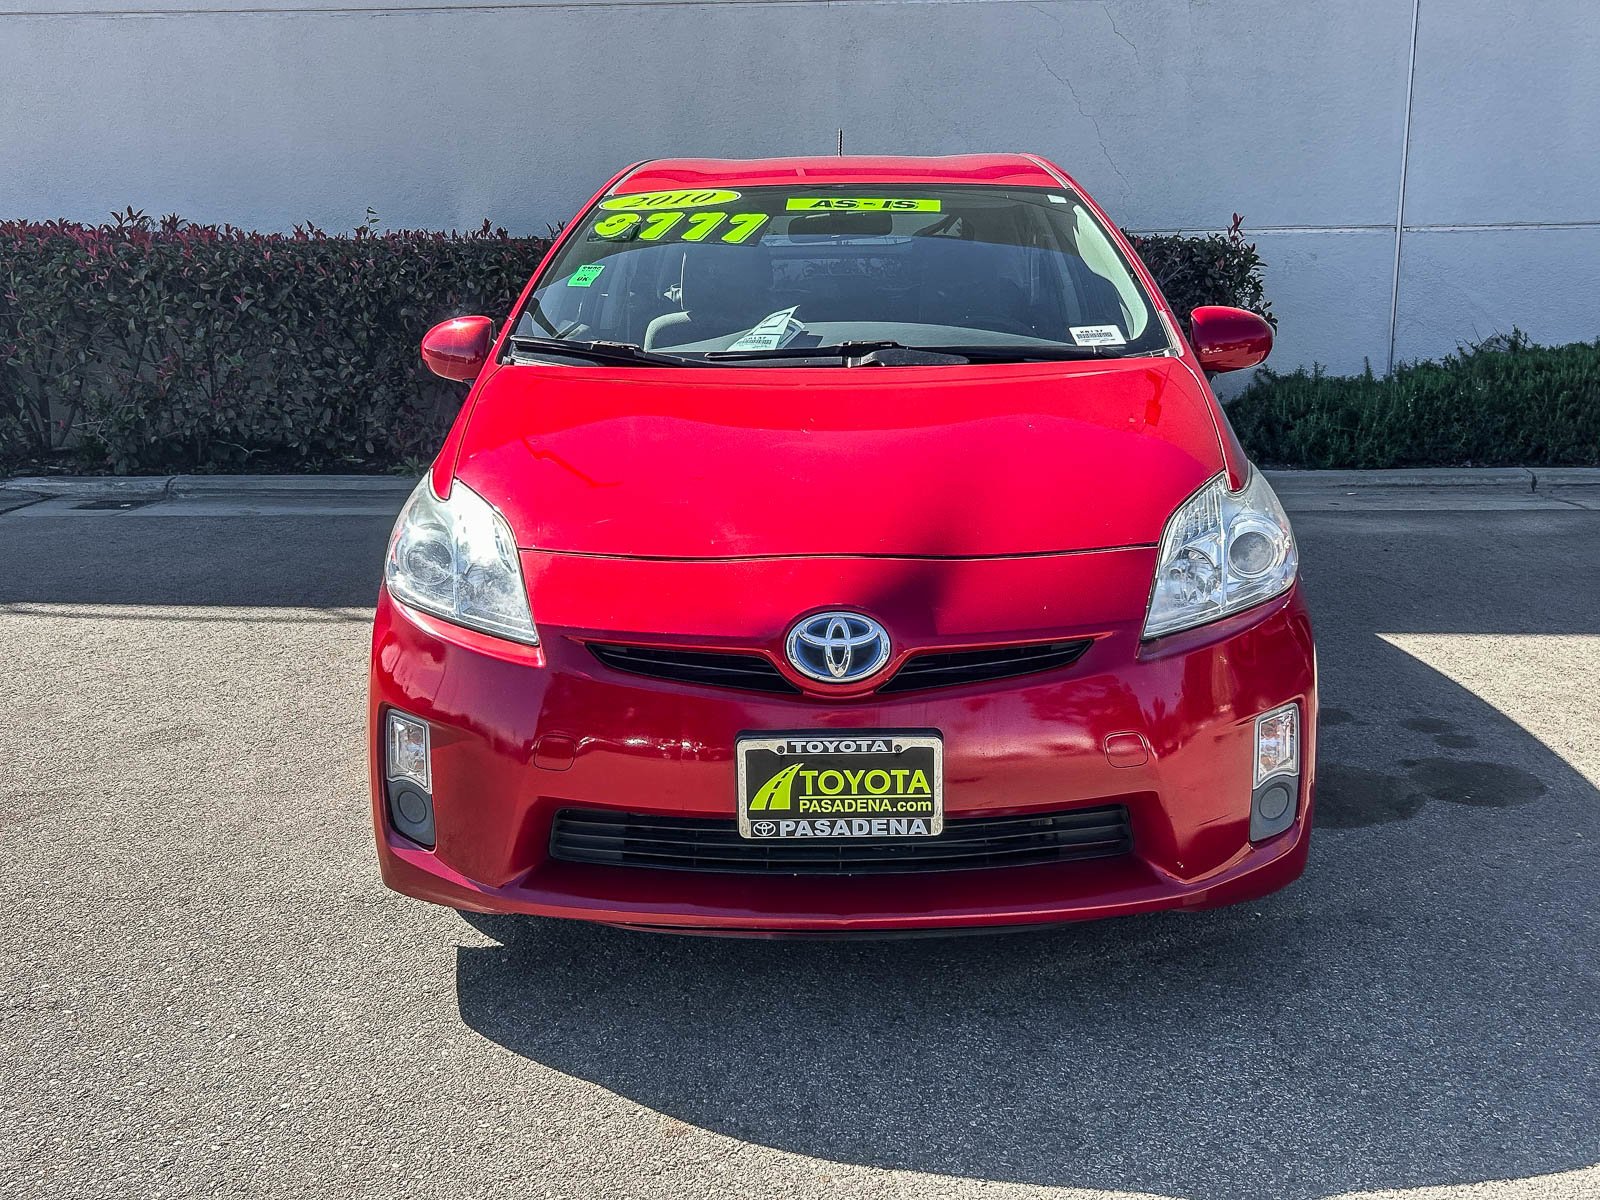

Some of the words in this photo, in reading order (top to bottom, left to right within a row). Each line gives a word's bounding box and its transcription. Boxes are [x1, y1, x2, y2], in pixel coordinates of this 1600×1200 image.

[622, 192, 717, 208] 2010
[809, 200, 919, 209] AS-IS
[790, 740, 888, 753] TOYOTA
[798, 769, 931, 795] TOYOTA
[799, 799, 932, 813] PASADENA.com
[779, 819, 929, 836] PASADENA
